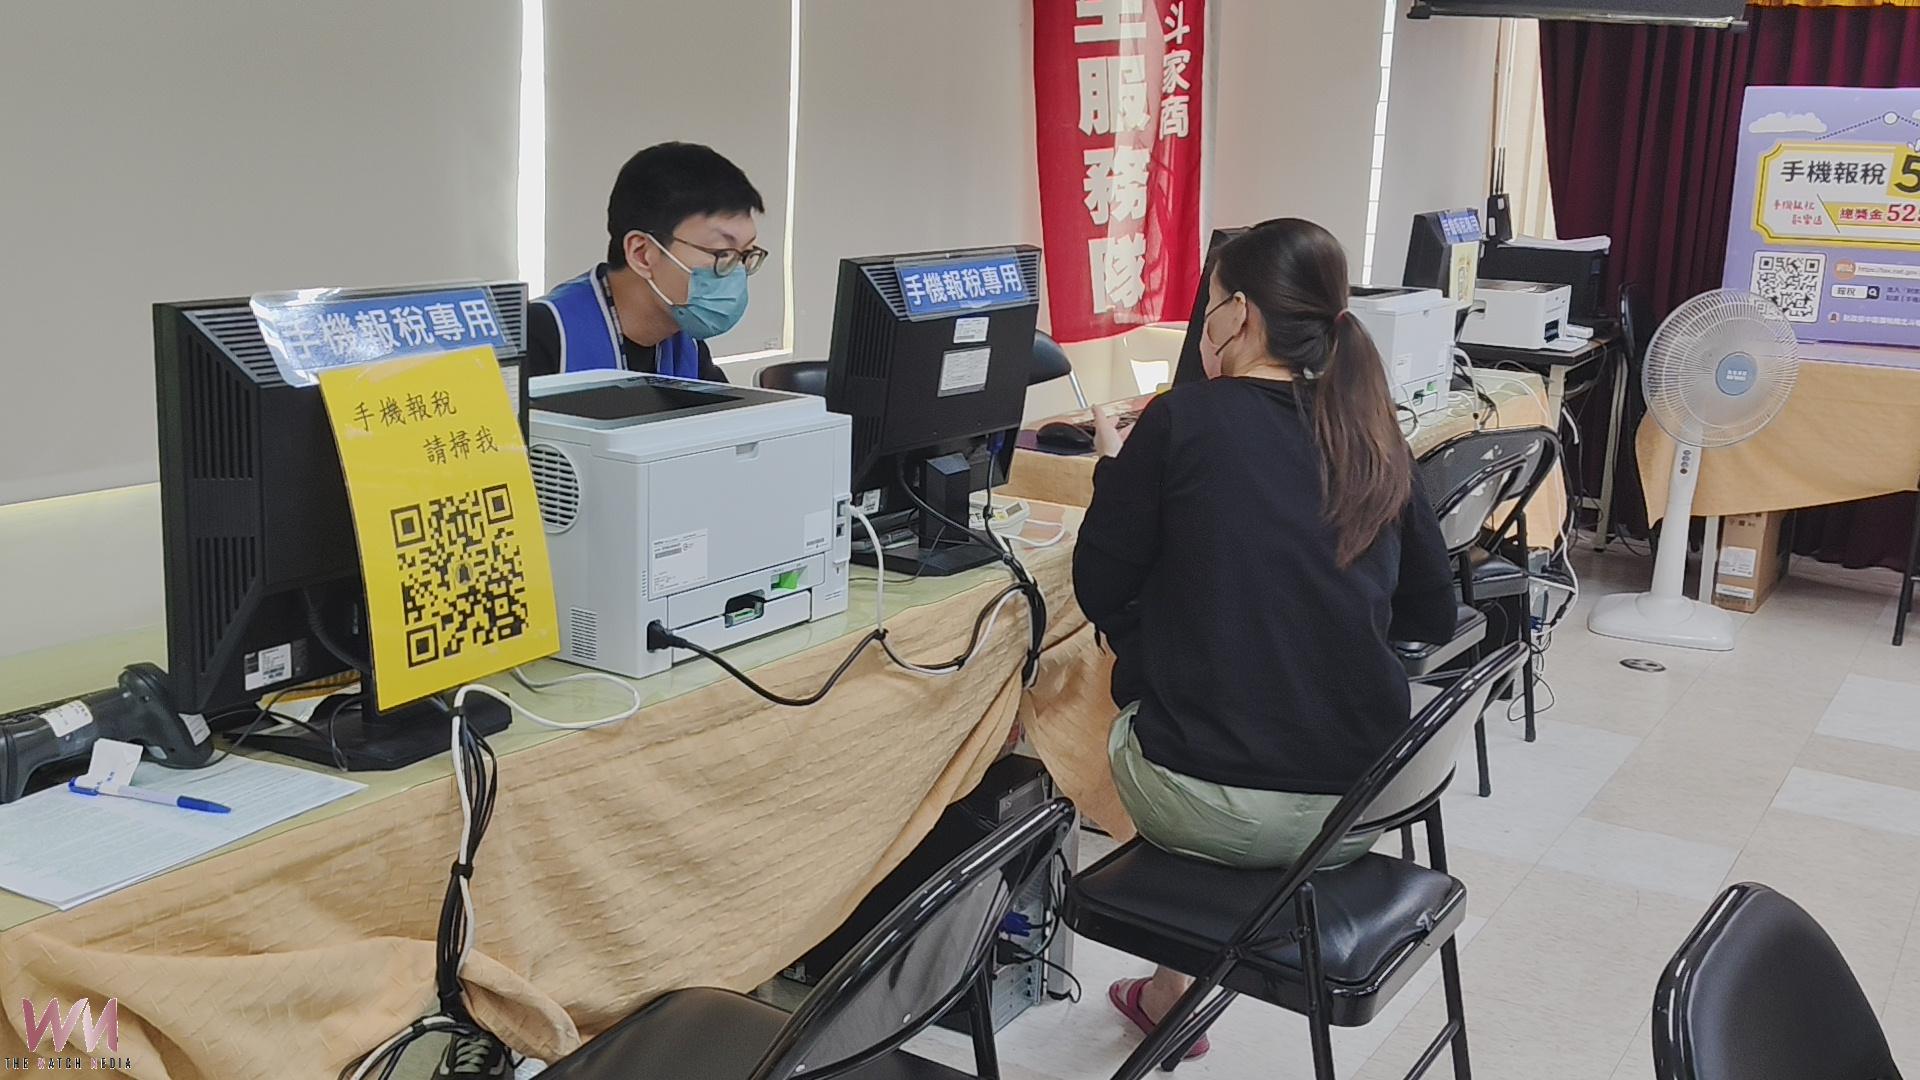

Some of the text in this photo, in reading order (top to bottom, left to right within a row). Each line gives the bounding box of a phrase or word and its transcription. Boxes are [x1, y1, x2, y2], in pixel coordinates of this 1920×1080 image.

[1781, 160, 1887, 185] 手機報稅
[904, 263, 1023, 306] 手機報稅專用
[279, 298, 500, 359] 手機報稅專用
[353, 390, 457, 432] 手機報稅
[423, 425, 499, 465] 請掃我
